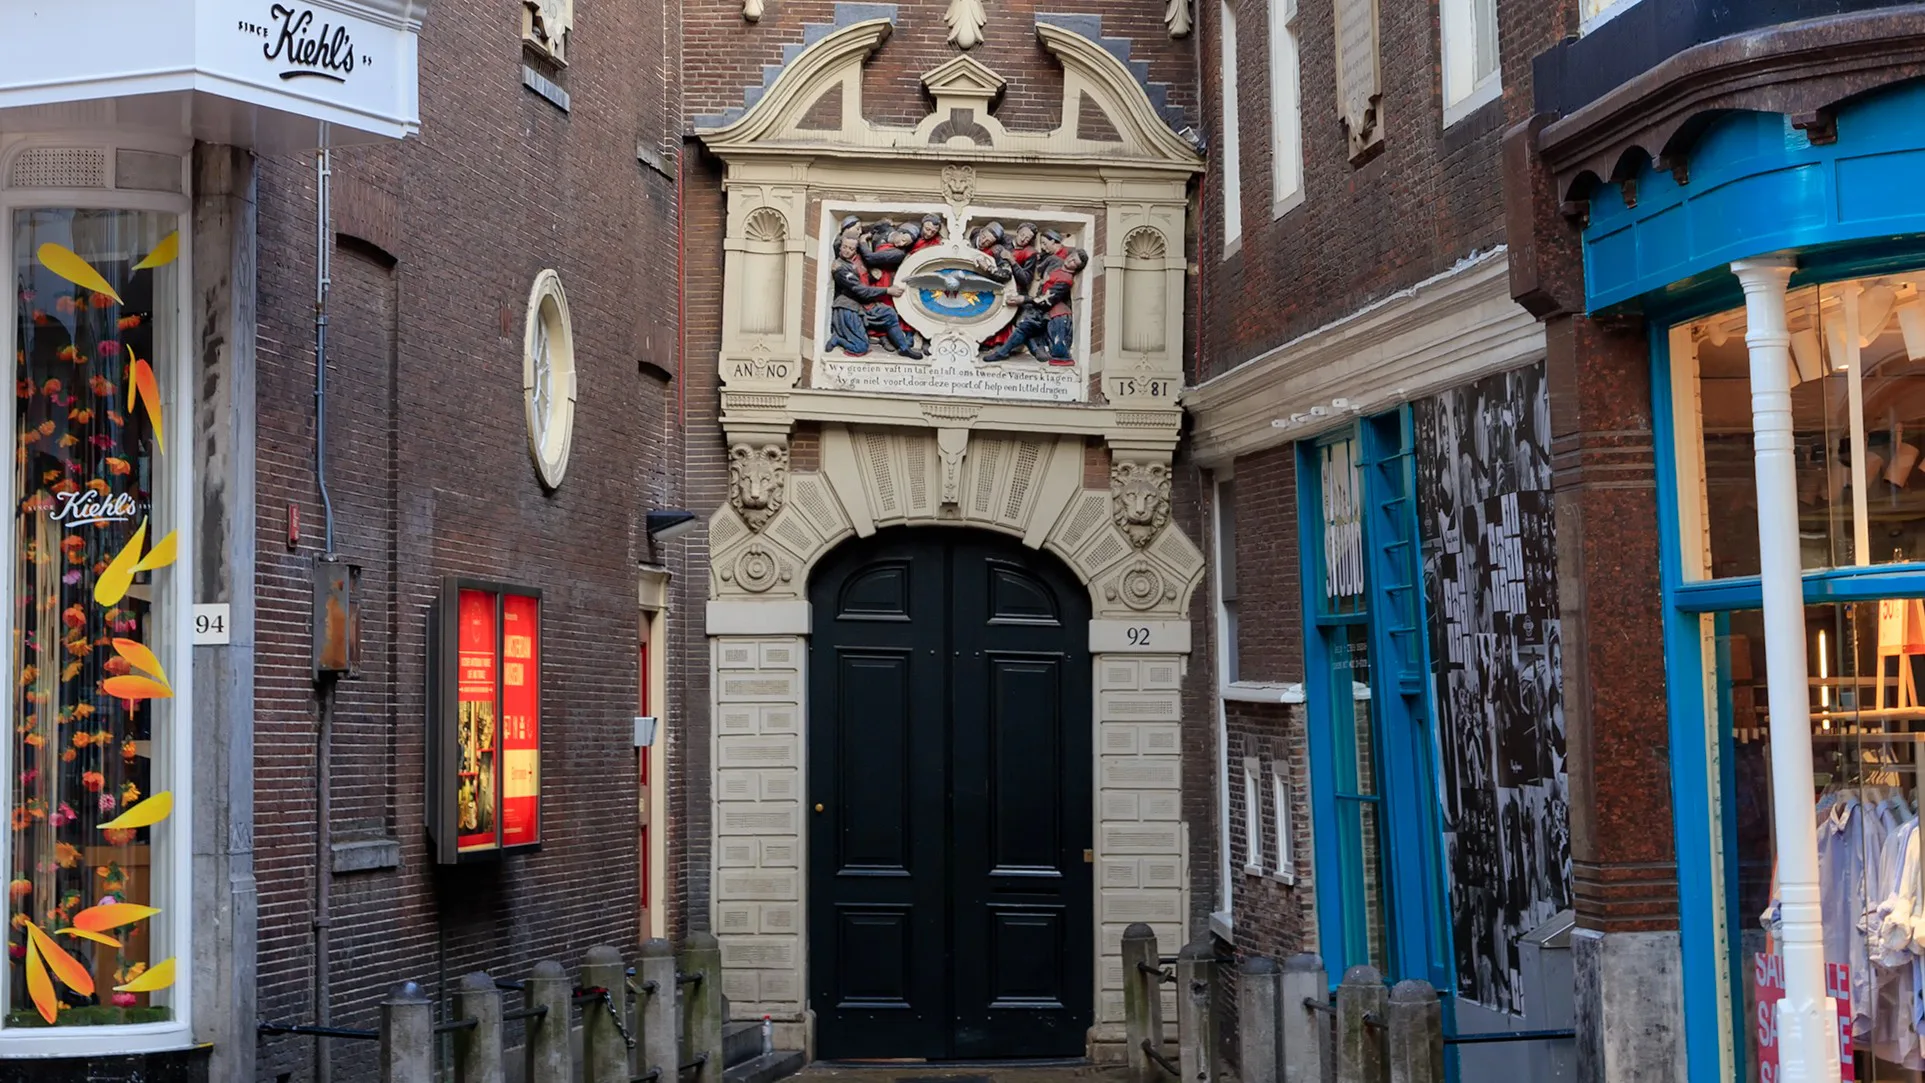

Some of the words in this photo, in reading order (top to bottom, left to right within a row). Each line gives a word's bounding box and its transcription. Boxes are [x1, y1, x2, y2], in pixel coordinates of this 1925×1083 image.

[238, 21, 269, 38] SINCE
[263, 3, 354, 73] Kiehl's
[958, 369, 974, 377] ons
[976, 369, 1007, 379] tweede
[1040, 373, 1073, 386] klagen
[984, 381, 1002, 396] help
[50, 489, 136, 520] Kiehl's
[195, 614, 225, 634] 94
[1127, 627, 1150, 646] 92
[1755, 953, 1786, 990] SAL
